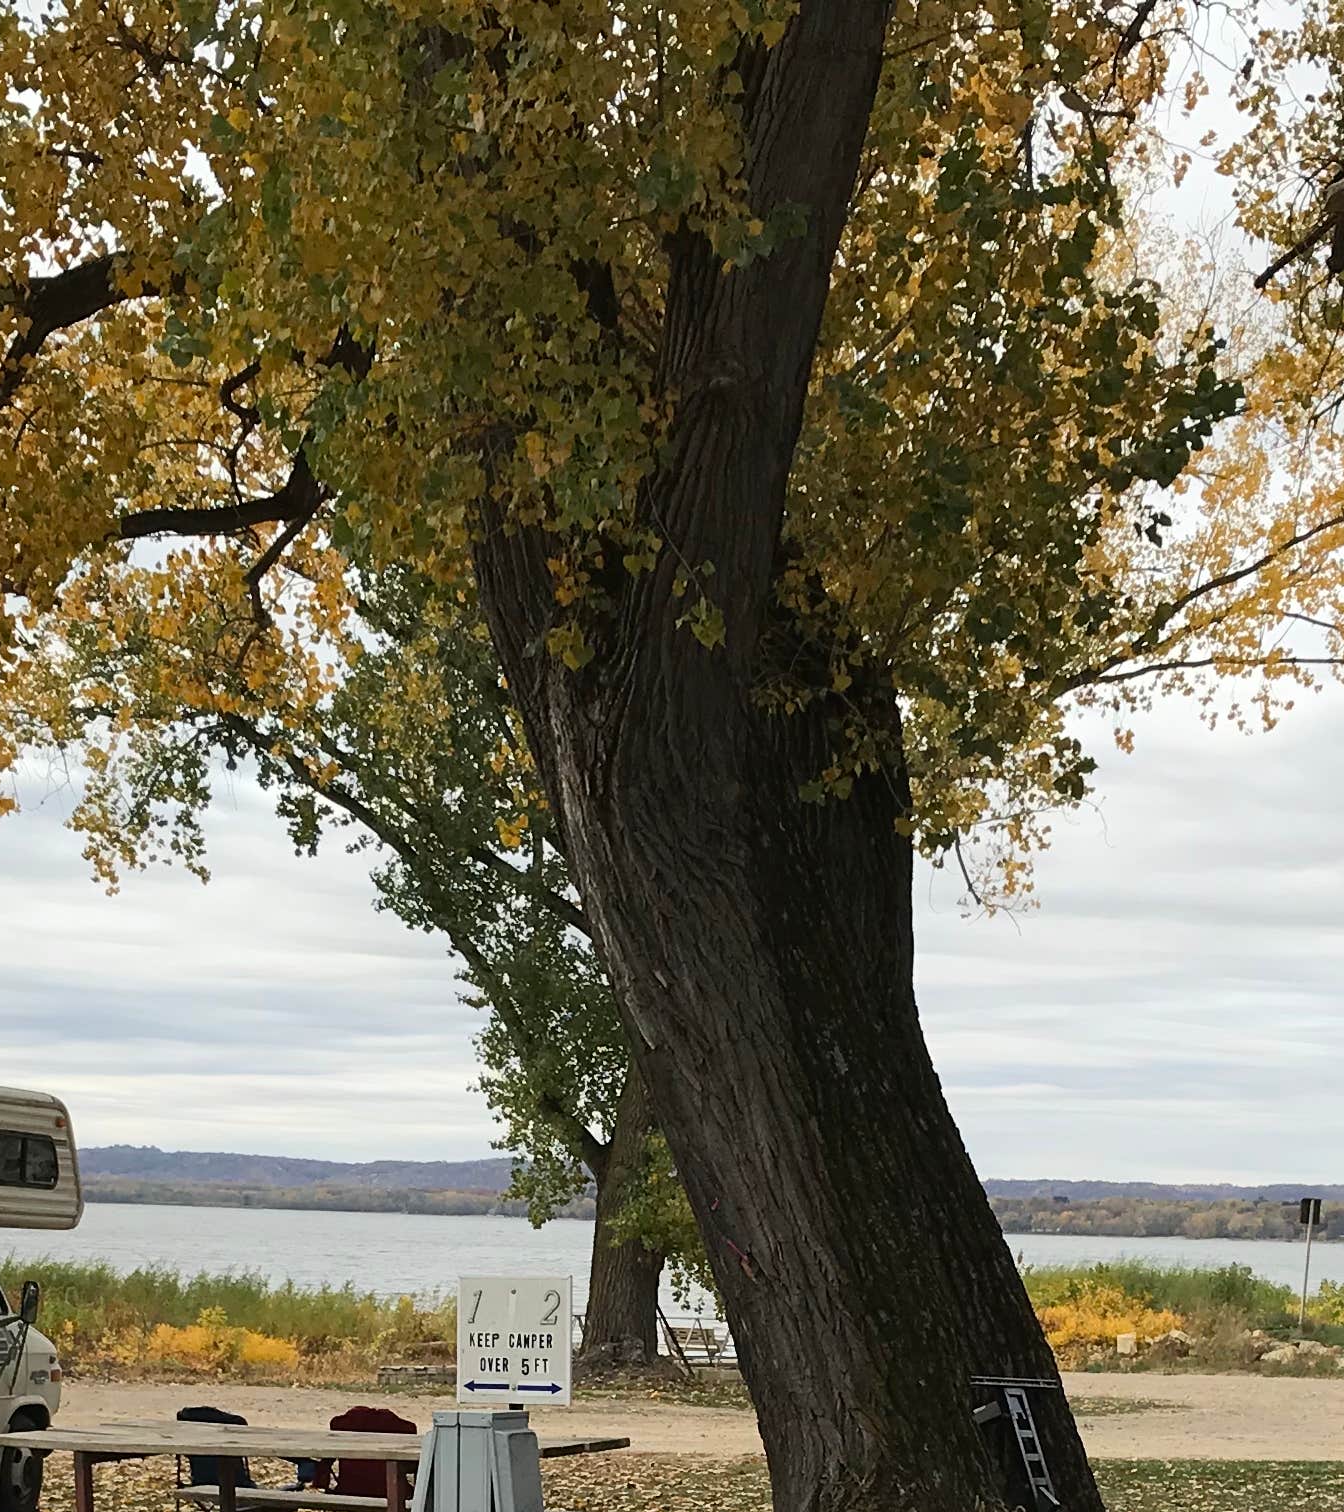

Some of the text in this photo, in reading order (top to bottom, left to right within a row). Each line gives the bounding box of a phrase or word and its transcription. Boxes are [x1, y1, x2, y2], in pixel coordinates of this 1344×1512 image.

[540, 1289, 561, 1326] 2
[469, 1332, 553, 1349] KEEP CAMPER
[479, 1357, 549, 1376] OVER 5 FT
